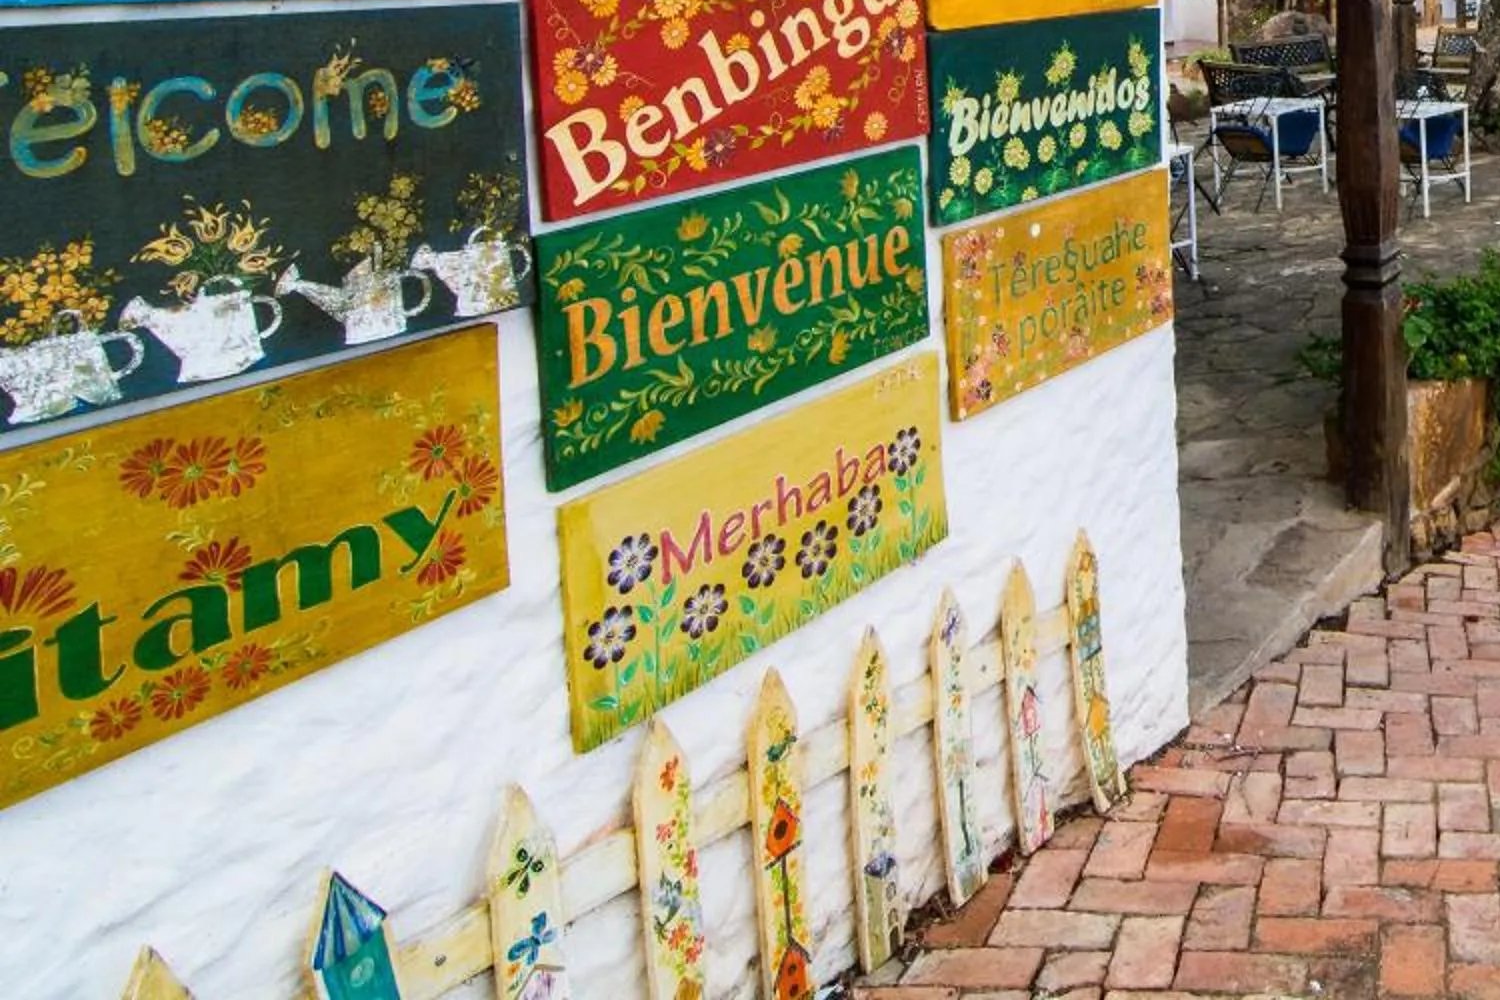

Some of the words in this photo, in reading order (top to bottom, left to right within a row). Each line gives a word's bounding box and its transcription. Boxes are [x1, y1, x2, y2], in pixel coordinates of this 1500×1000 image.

[0, 60, 460, 178] elcome
[948, 66, 1151, 157] Bienvenidos
[658, 441, 890, 586] Merhaba
